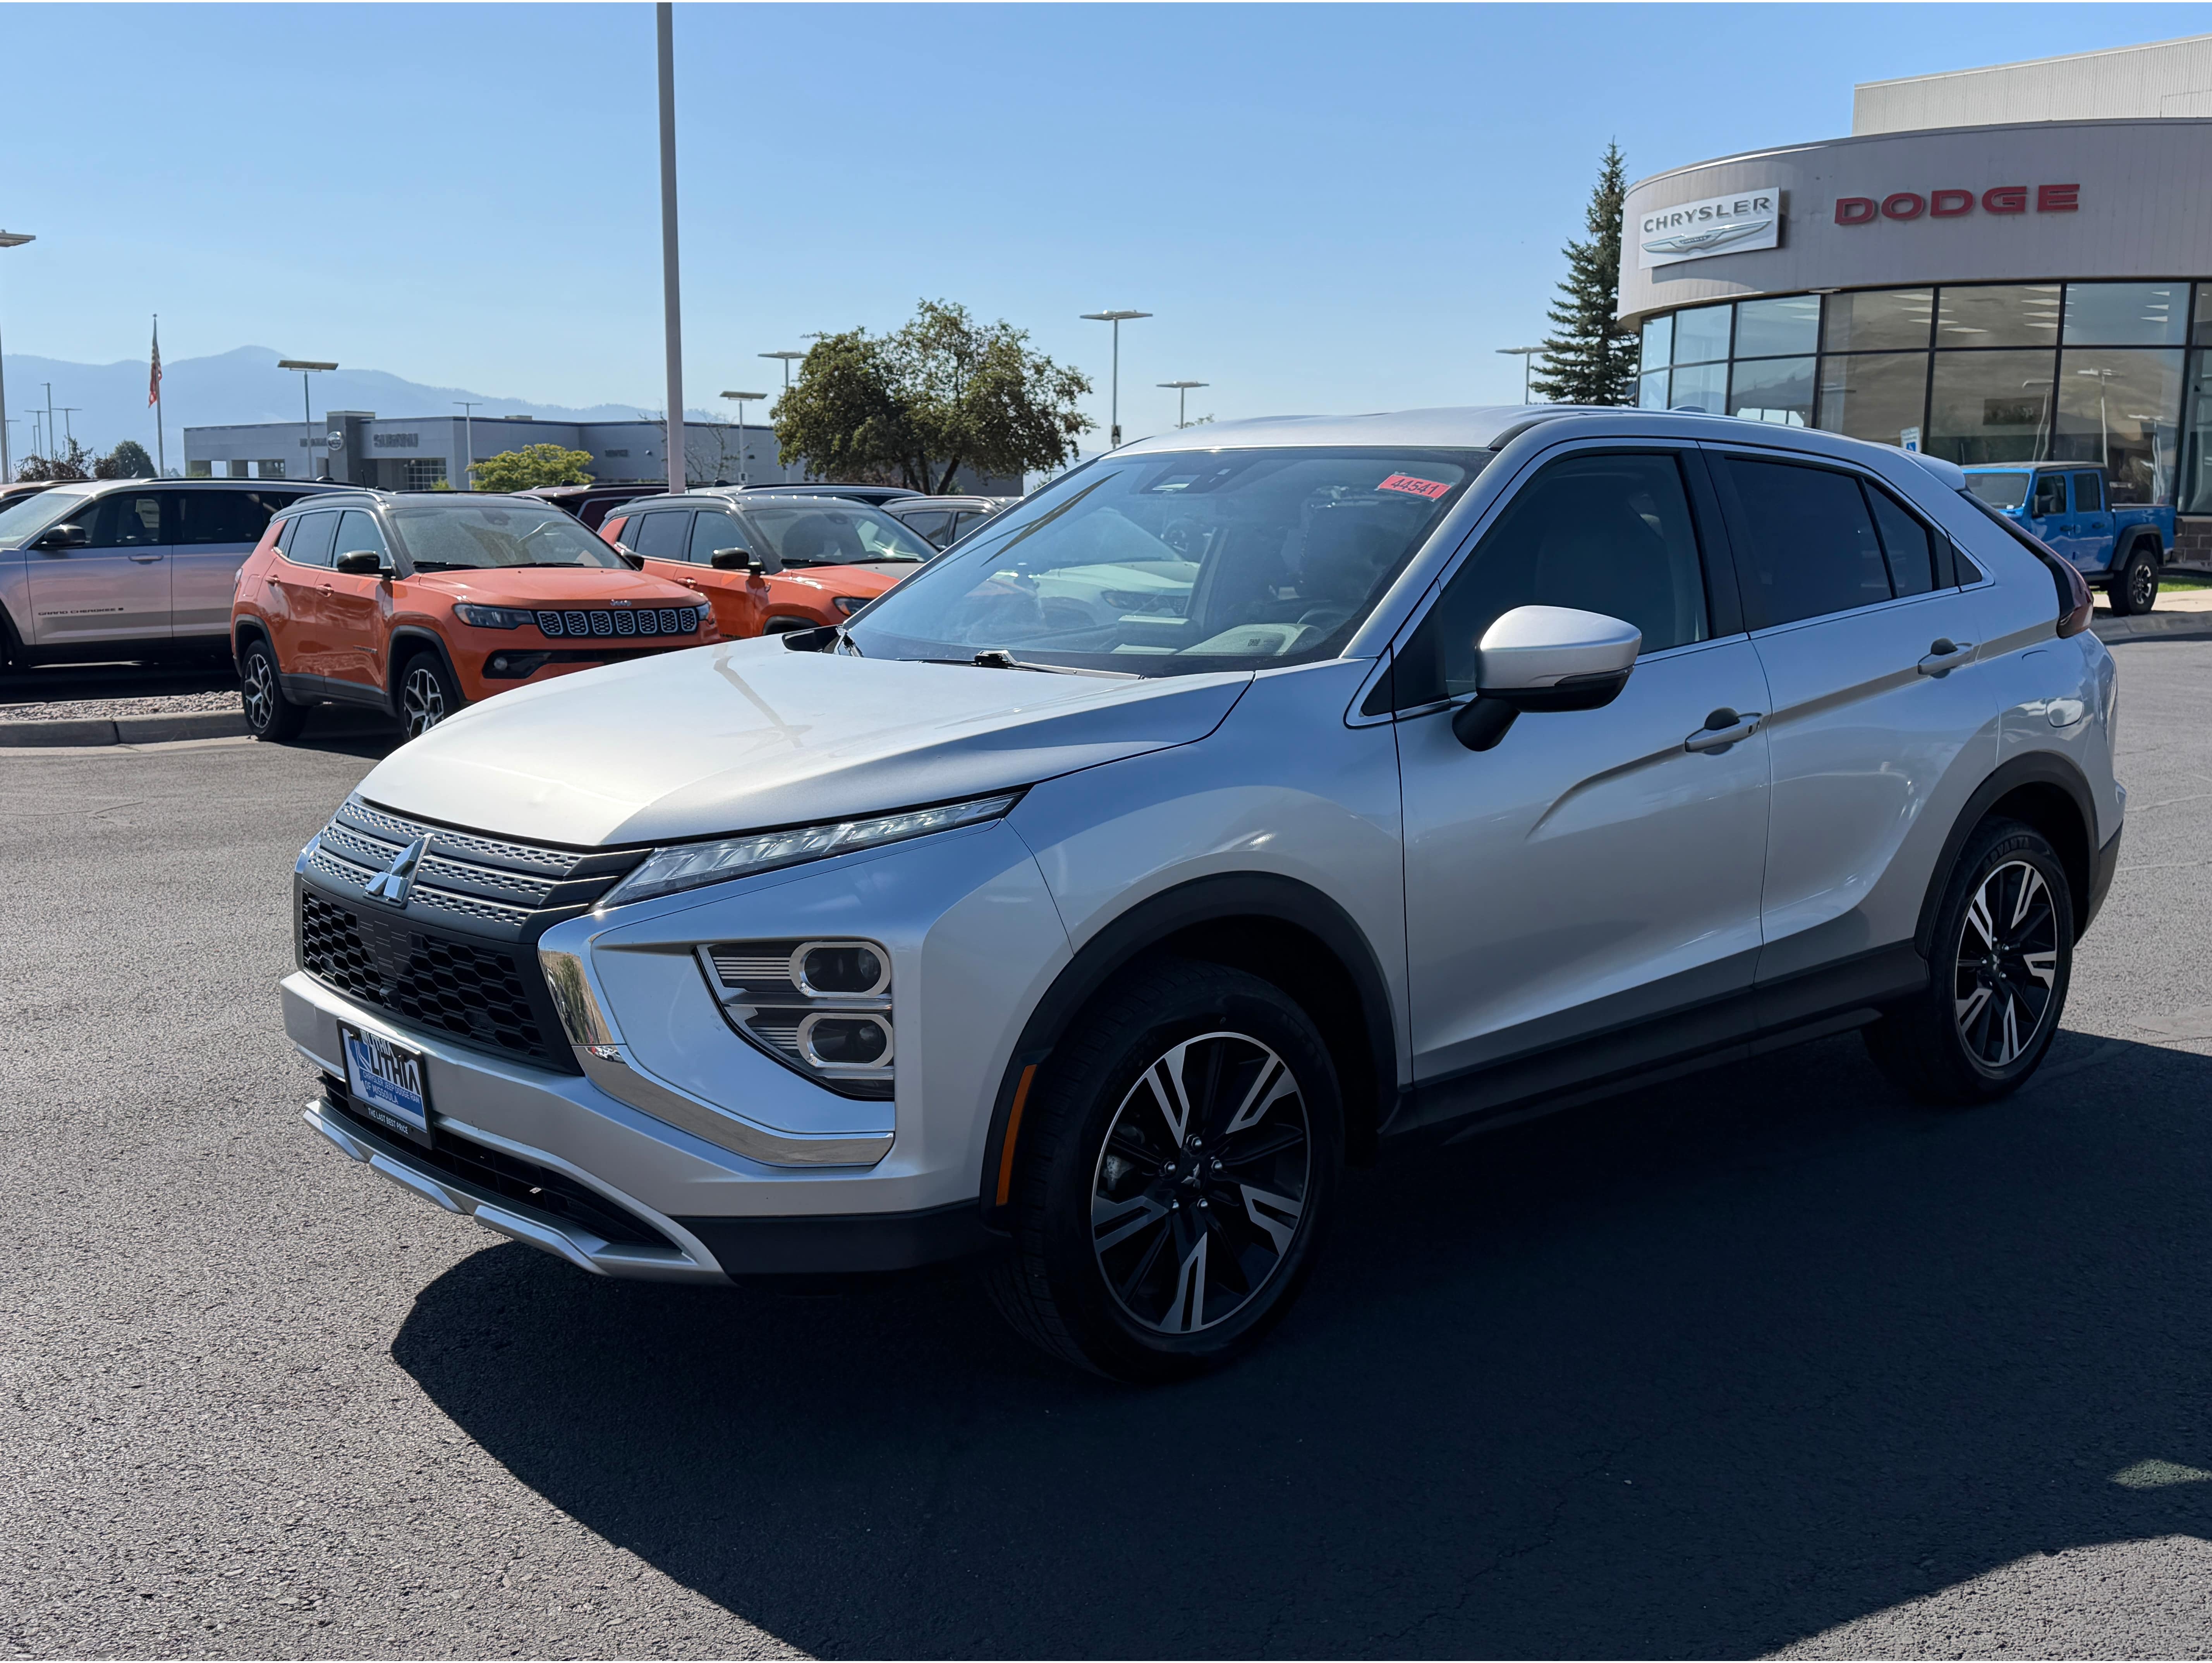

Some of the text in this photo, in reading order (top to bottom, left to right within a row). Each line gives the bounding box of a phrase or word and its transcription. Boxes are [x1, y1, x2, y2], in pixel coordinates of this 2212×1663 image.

[1644, 197, 1770, 233] CHRYSLER
[1834, 184, 2080, 224] DODGE
[374, 433, 418, 448] SUBARU
[1391, 478, 1439, 495] 44541
[368, 1045, 421, 1095] LITHIA
[363, 1071, 420, 1104] CHRYSLER JEEP DODGE RAM
[364, 1081, 398, 1104] OF MISSOULA
[368, 1107, 408, 1134] THE LAST BEST PRICE
